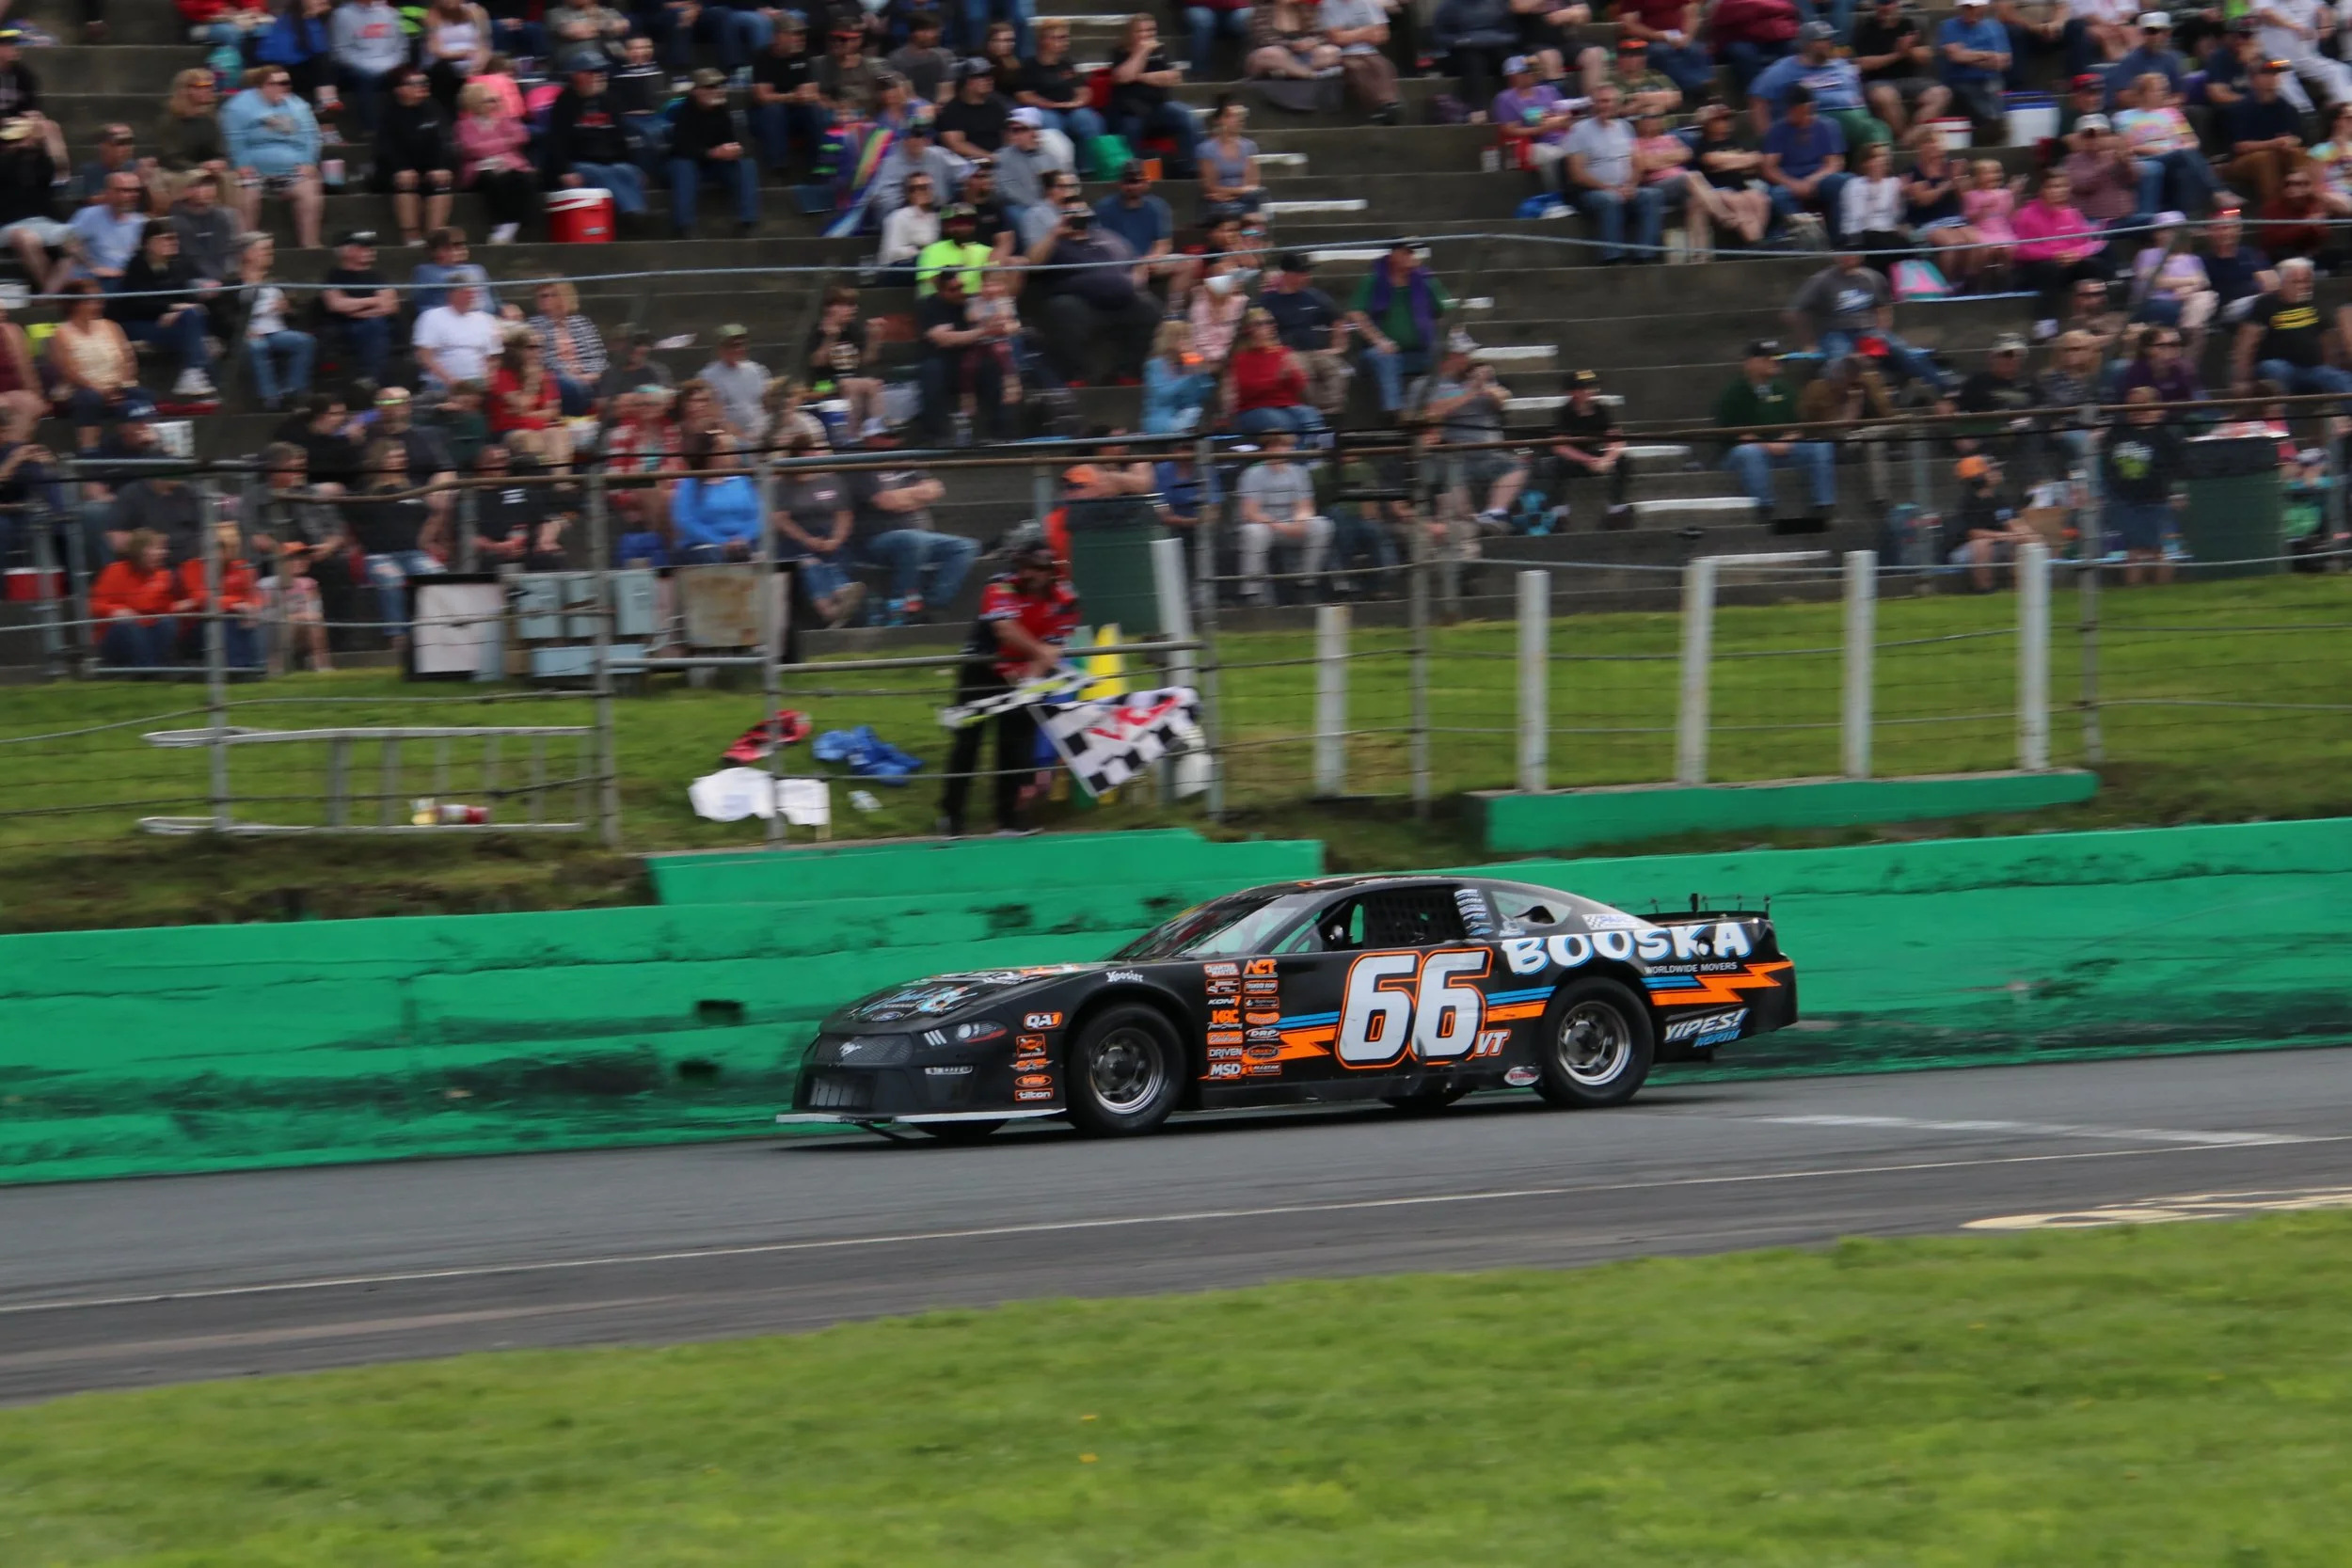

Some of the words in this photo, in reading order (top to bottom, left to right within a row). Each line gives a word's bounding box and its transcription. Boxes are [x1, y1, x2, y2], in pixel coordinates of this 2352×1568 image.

[1501, 923, 1754, 975] BOOSKA
[1244, 958, 1277, 974] ACT
[1645, 964, 1698, 974] WORLDWIDE
[1701, 962, 1738, 972] MOVERS
[1335, 948, 1494, 1069] 66
[1026, 1014, 1060, 1028] QA1
[1663, 1007, 1750, 1044] YIPES!
[1475, 1029, 1511, 1056] VT
[1209, 1048, 1242, 1059] DRIVEN
[1210, 1063, 1241, 1076] MSD
